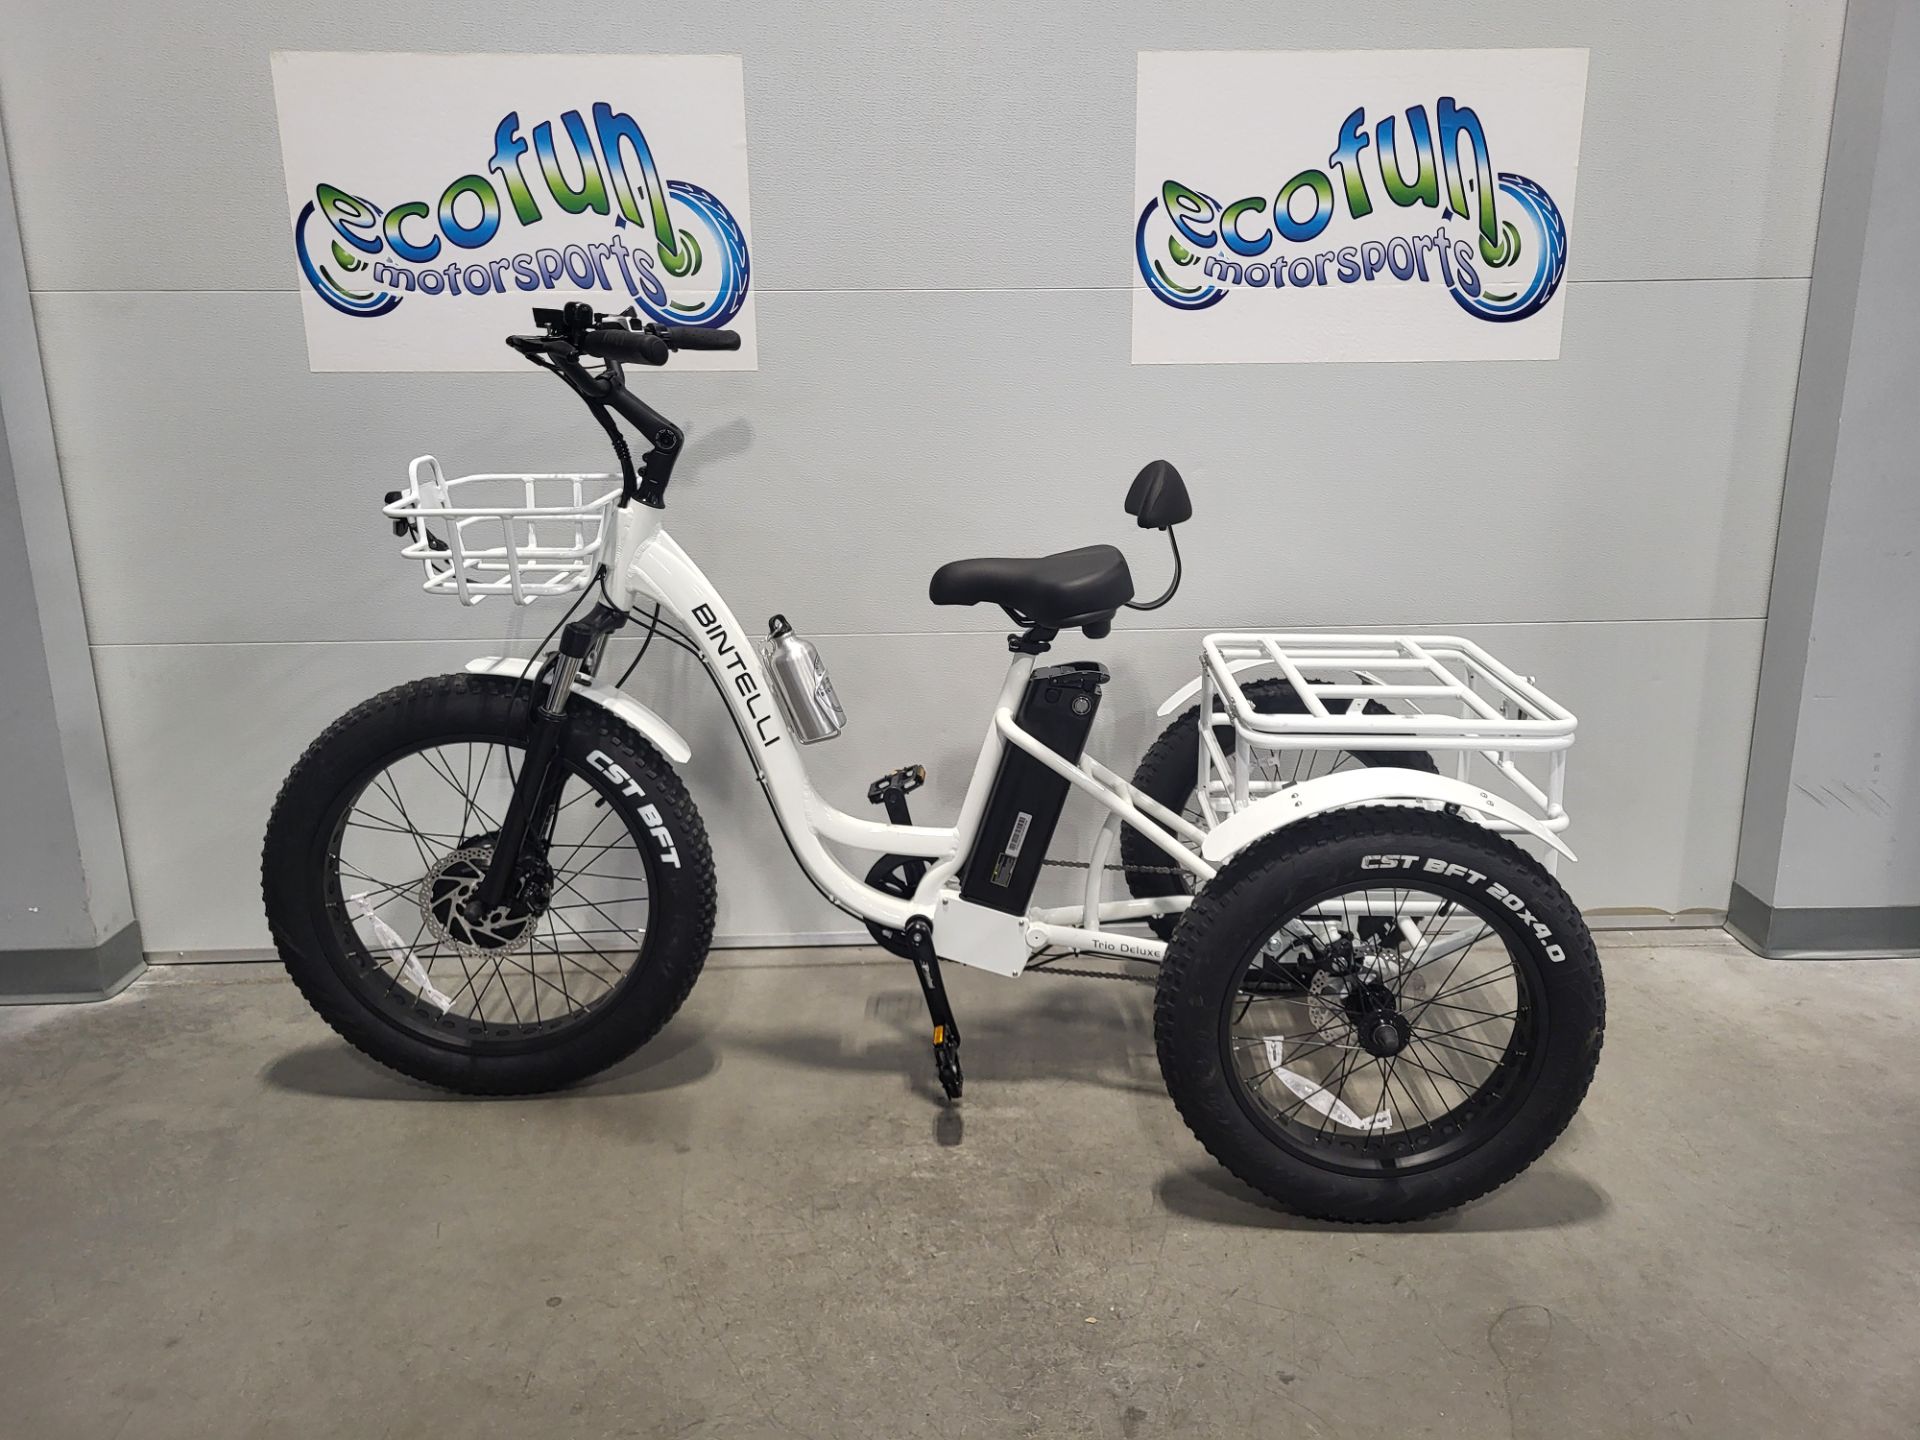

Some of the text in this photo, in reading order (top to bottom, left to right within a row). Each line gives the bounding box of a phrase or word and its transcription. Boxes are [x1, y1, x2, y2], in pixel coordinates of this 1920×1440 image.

[373, 235, 666, 307] motorsports
[1204, 227, 1482, 298] motorsports
[692, 603, 781, 748] BINTELLI
[586, 750, 682, 869] CST BFT
[1360, 854, 1420, 870] CST
[1423, 858, 1487, 885] BFT
[1092, 939, 1161, 958] Trio Deluxe
